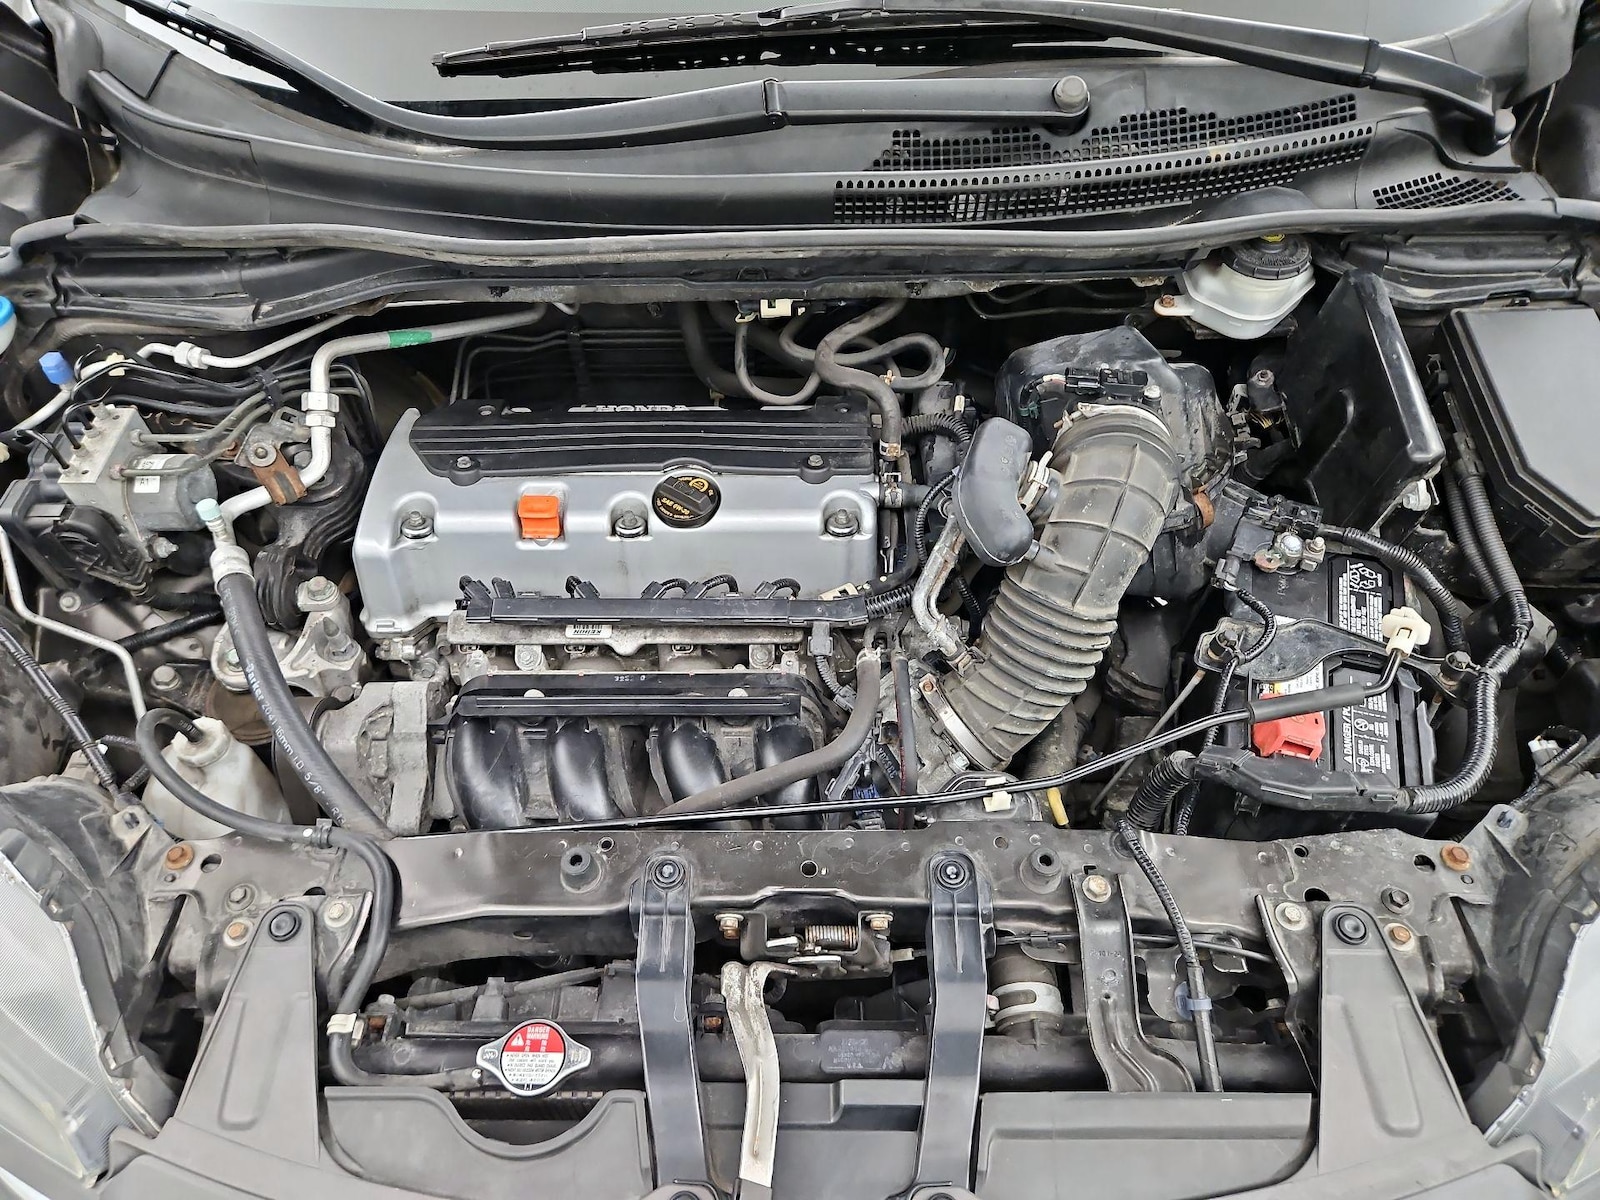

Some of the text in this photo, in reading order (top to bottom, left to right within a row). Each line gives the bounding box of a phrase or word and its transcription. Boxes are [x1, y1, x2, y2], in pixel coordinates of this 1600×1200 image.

[595, 404, 690, 412] HONDA
[661, 497, 674, 507] SAE
[276, 726, 294, 756] 16mm
